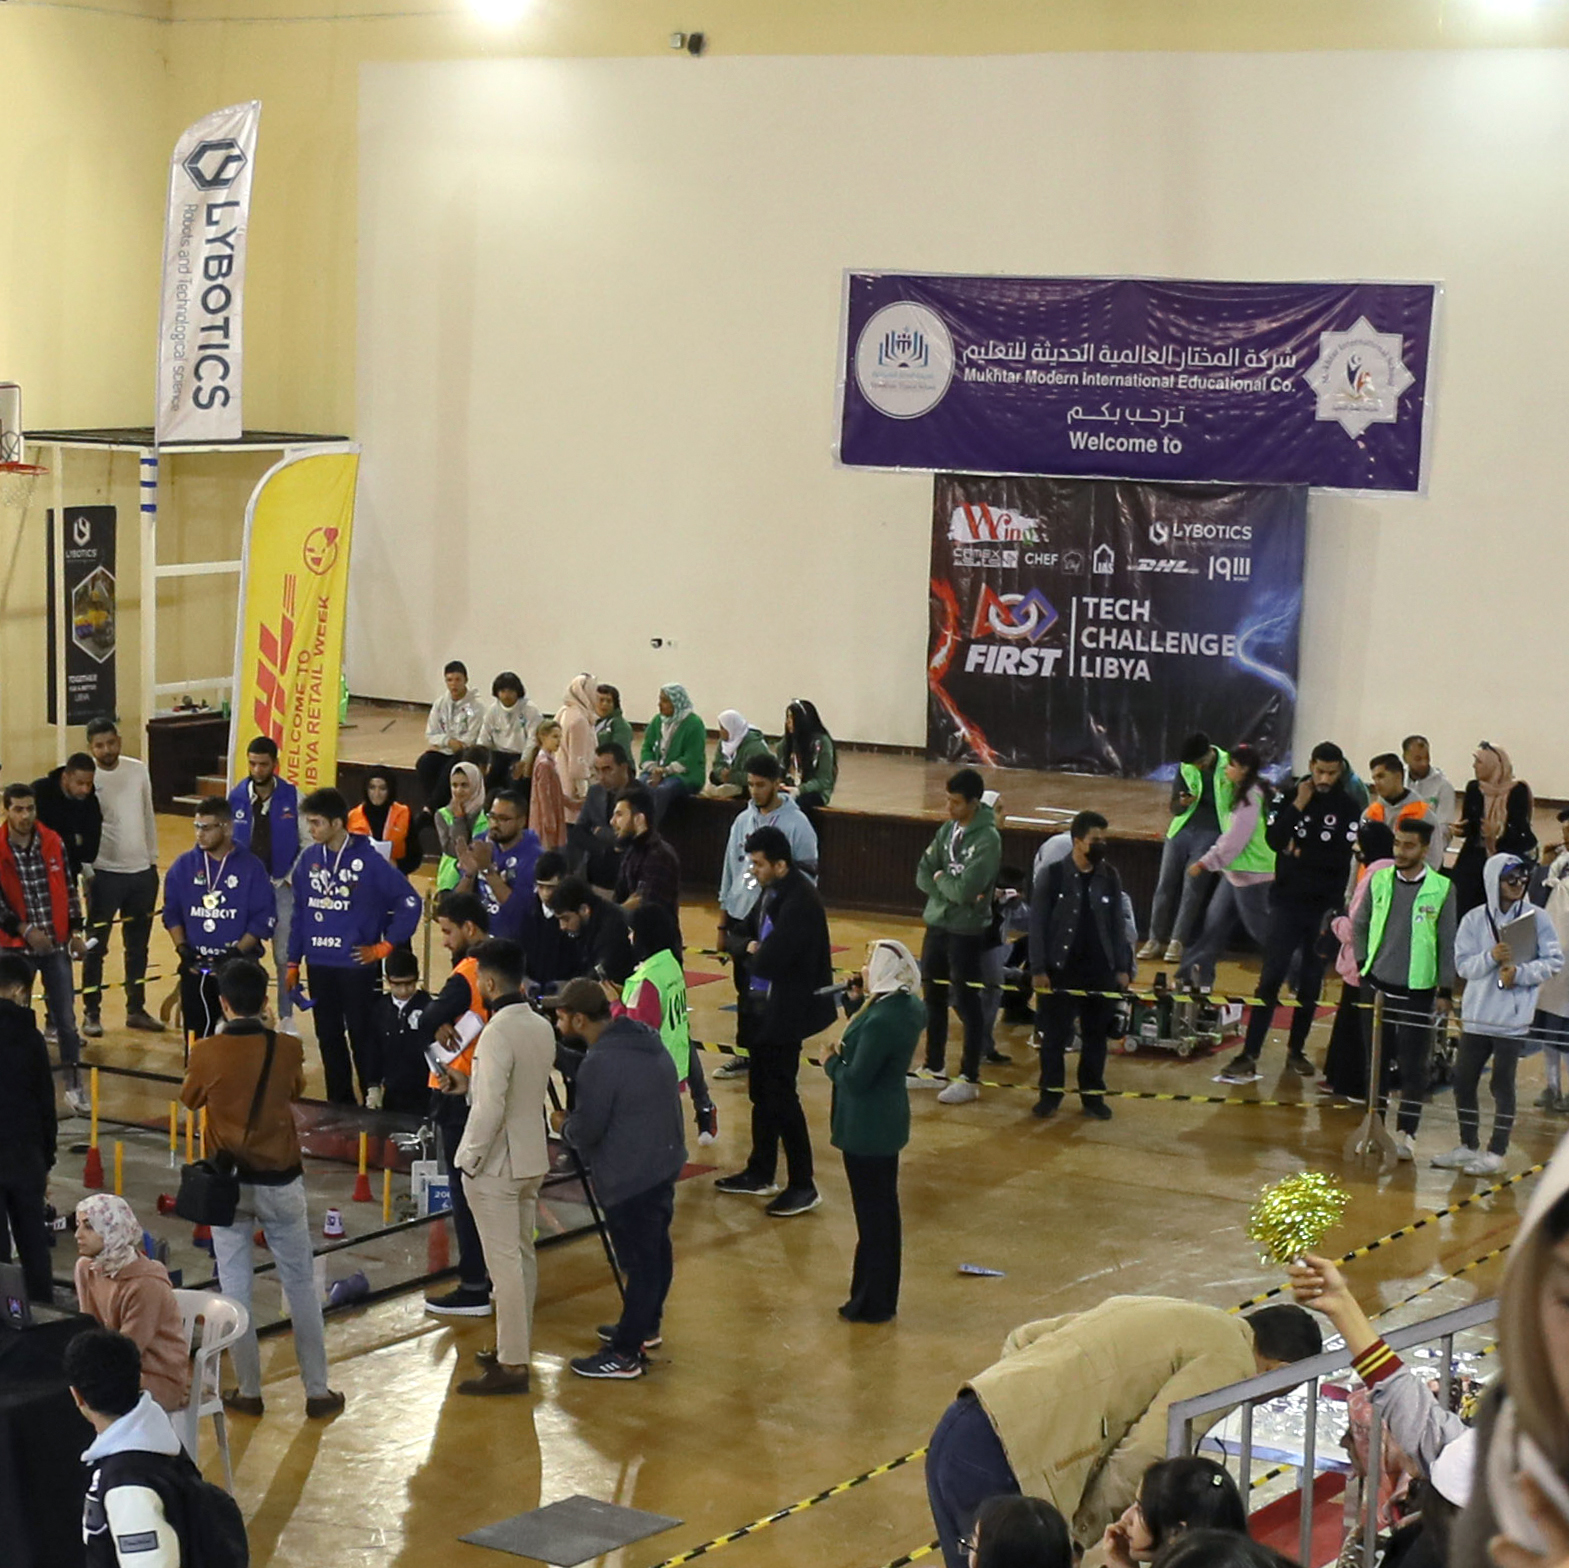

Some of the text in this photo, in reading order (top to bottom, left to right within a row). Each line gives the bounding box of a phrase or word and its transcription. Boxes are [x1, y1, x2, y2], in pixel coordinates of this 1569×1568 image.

[181, 204, 199, 246] Robots
[179, 250, 192, 270] and
[170, 272, 192, 360] Technological
[192, 201, 240, 410] LYBOTICS
[963, 340, 1026, 364] للتعليم
[1032, 341, 1094, 366] الحديثة
[1099, 344, 1173, 367] العالمية
[1176, 346, 1239, 371] المختار
[1244, 347, 1297, 374] شركة
[964, 368, 1296, 392] Mukhtar Modern International Educational Co.
[1069, 431, 1182, 454] Welcome to
[1173, 524, 1252, 540] LYBOTICS
[1024, 553, 1059, 565] CHEF
[1137, 558, 1189, 573] DHL
[1082, 597, 1150, 622] TECH
[1081, 627, 1236, 657] CHALLENGE
[297, 649, 311, 677] TO
[964, 645, 1151, 681] FIRST LIBYA
[304, 596, 330, 795] IBYA RETAIL WEEK
[311, 936, 342, 948] 18492
